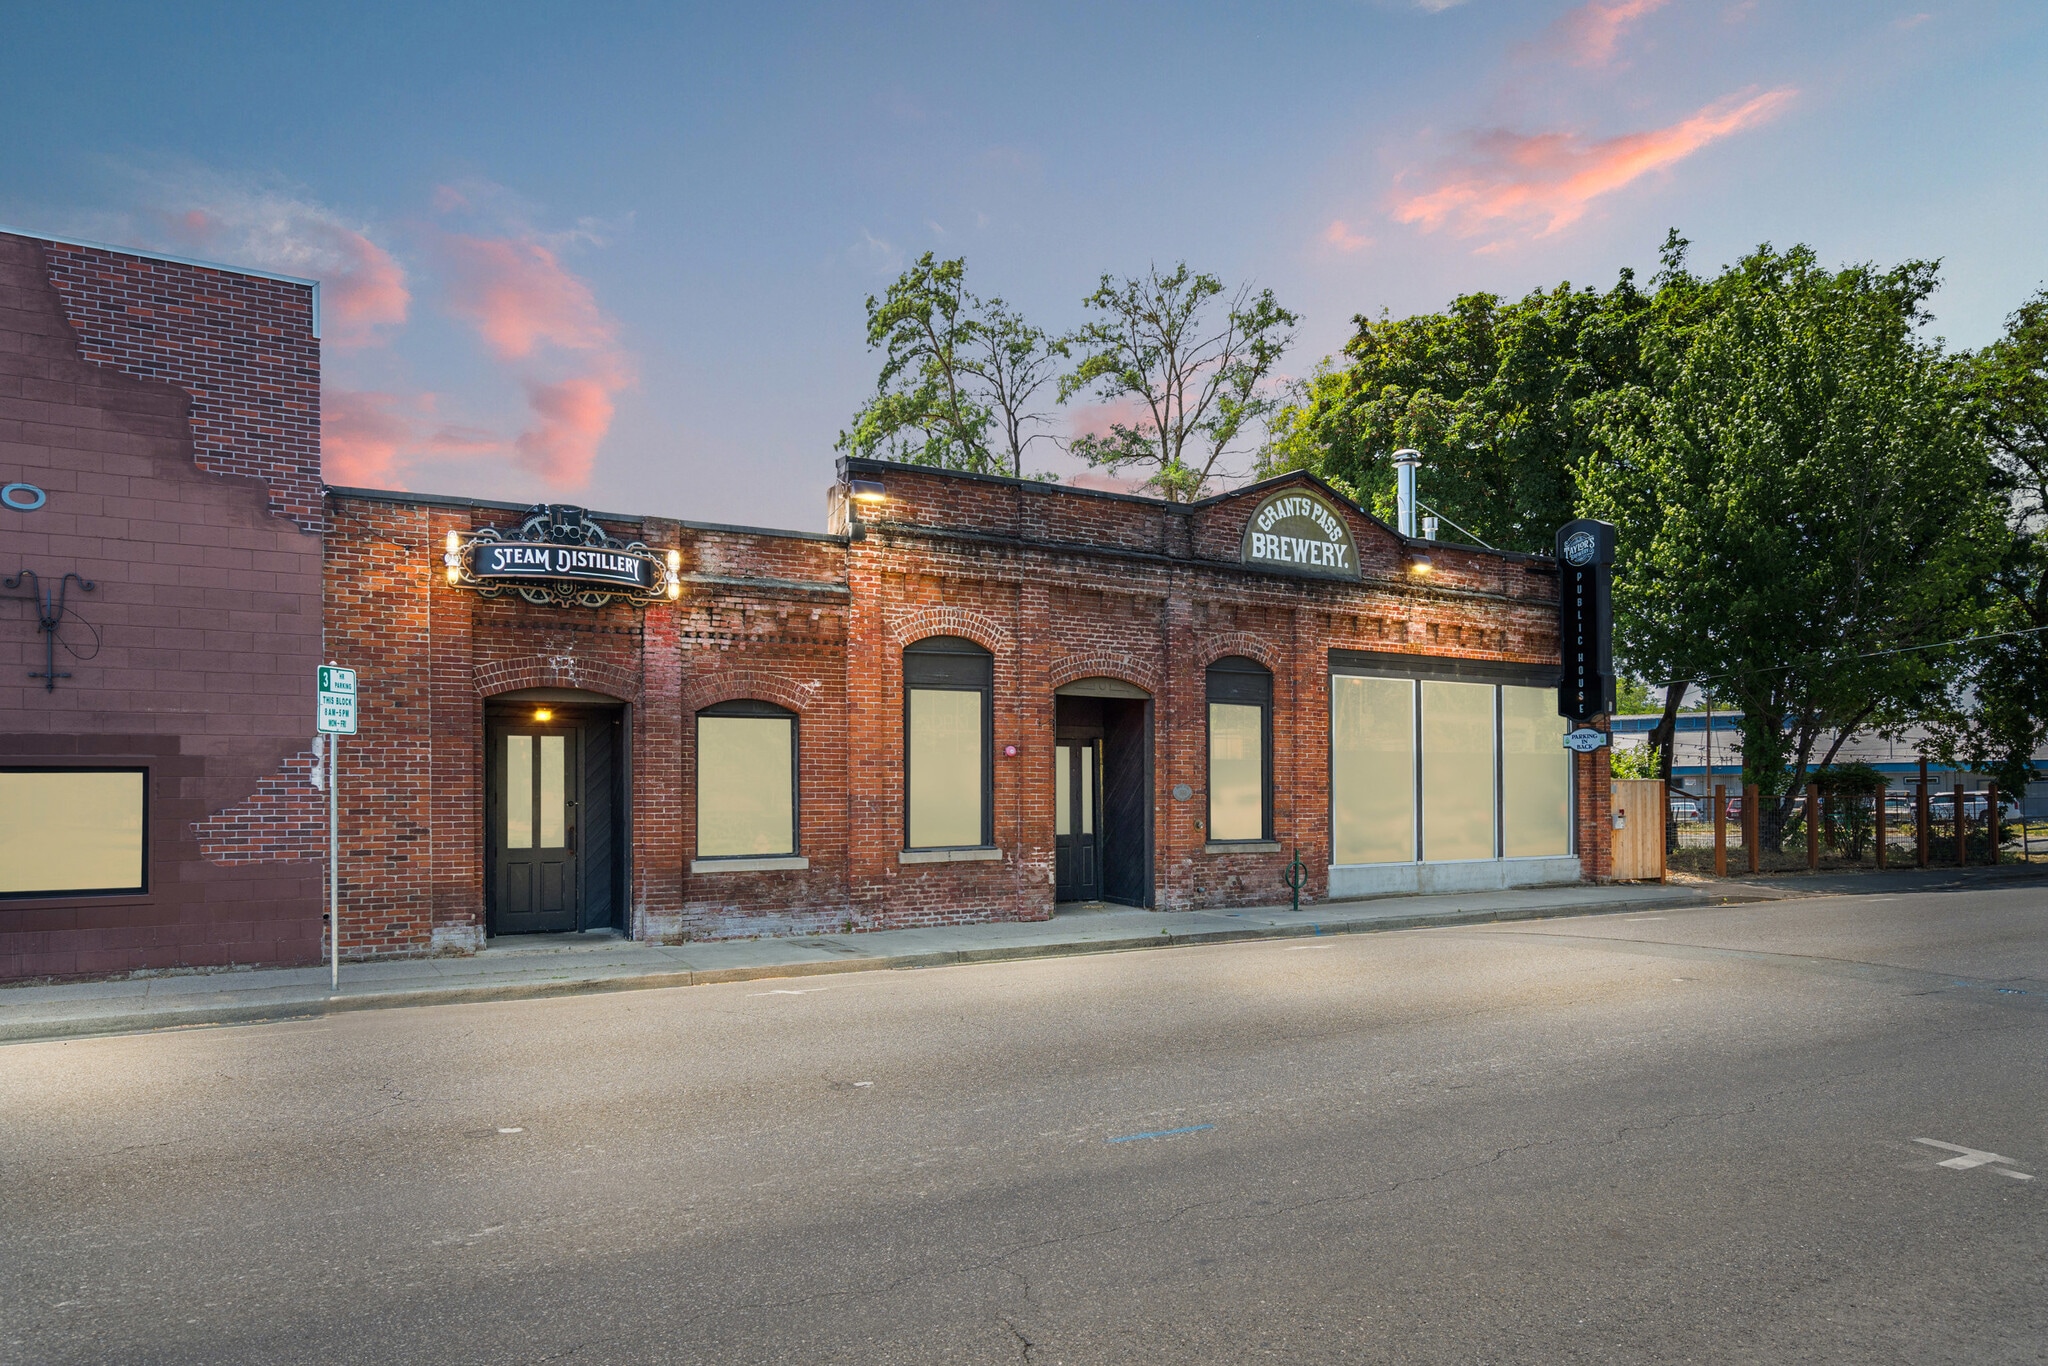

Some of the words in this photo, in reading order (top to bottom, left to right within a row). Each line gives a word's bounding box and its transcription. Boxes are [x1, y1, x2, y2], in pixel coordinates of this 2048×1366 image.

[1257, 497, 1312, 532] GRANTS
[1311, 502, 1343, 542] PASS
[491, 549, 552, 571] STEAM
[556, 550, 640, 581] DISTILLERY
[323, 672, 329, 688] 3
[334, 682, 352, 690] PARKING
[1577, 652, 1585, 714] HOUSE
[323, 696, 334, 705] THIS
[336, 697, 352, 706] BLOCK
